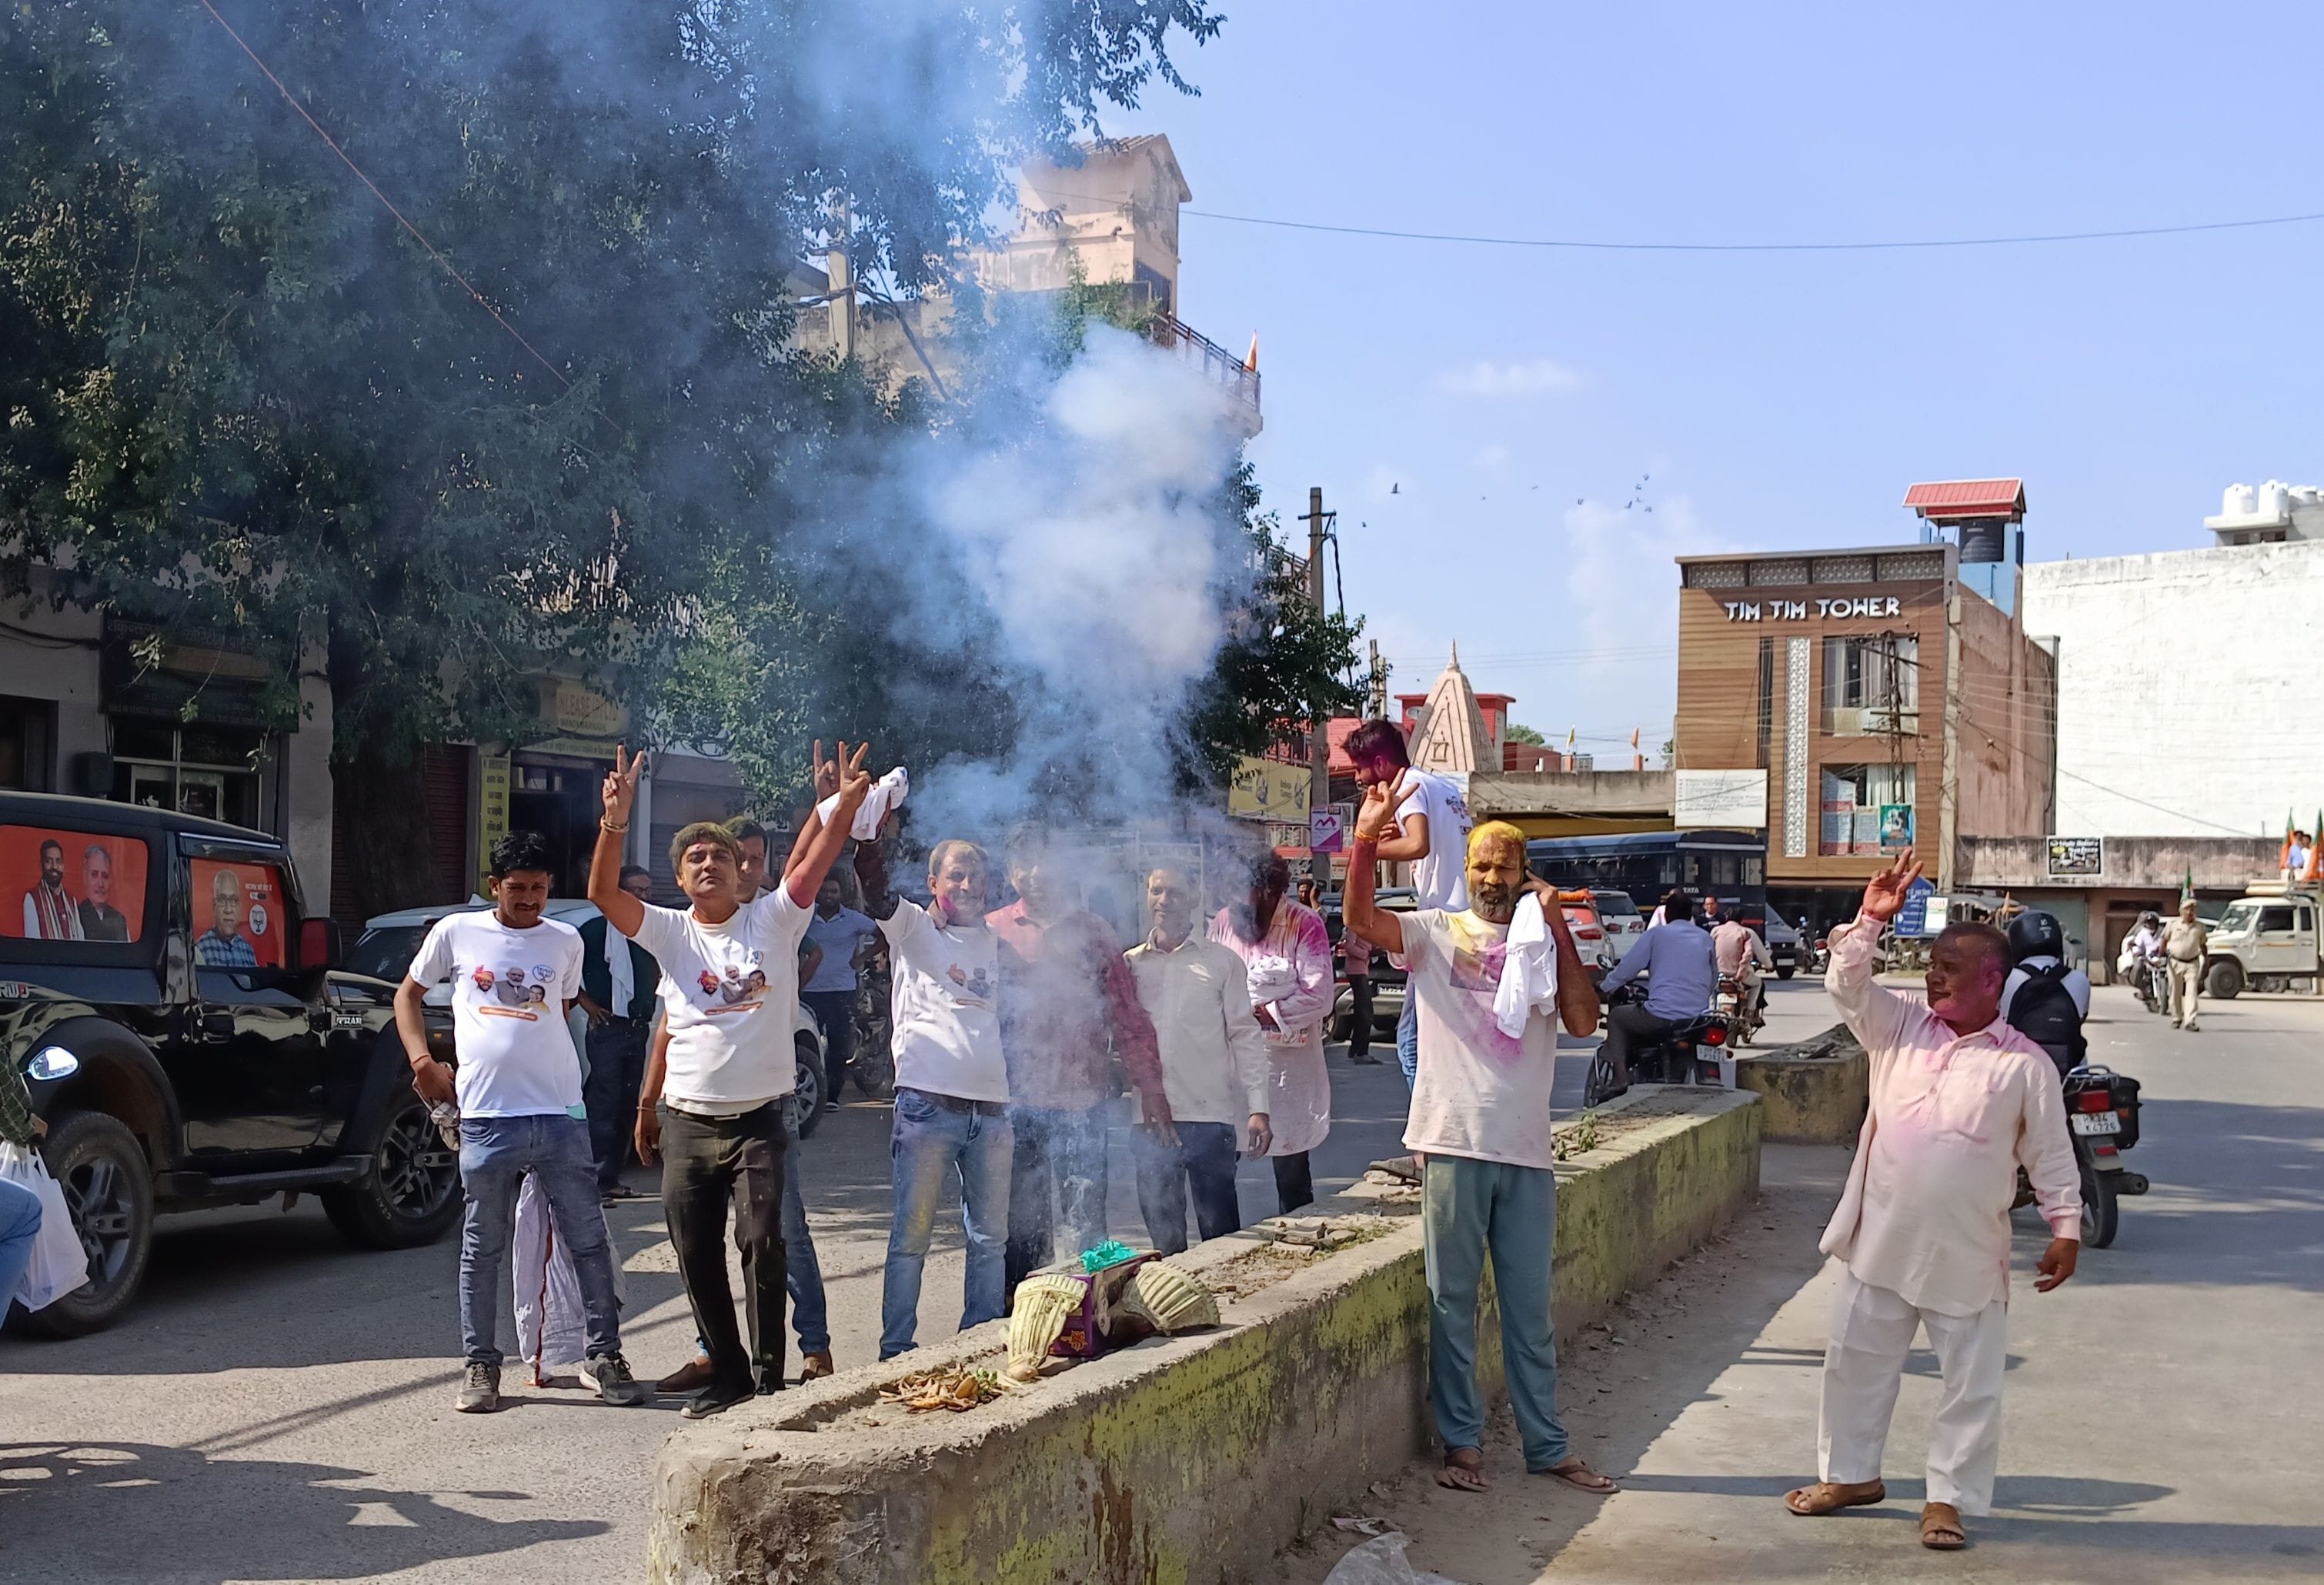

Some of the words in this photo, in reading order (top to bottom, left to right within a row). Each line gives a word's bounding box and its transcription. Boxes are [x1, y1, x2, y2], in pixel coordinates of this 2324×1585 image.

[1724, 601, 1761, 622] TIM
[1768, 600, 1807, 620] TIM
[1815, 596, 1901, 619] TOWER
